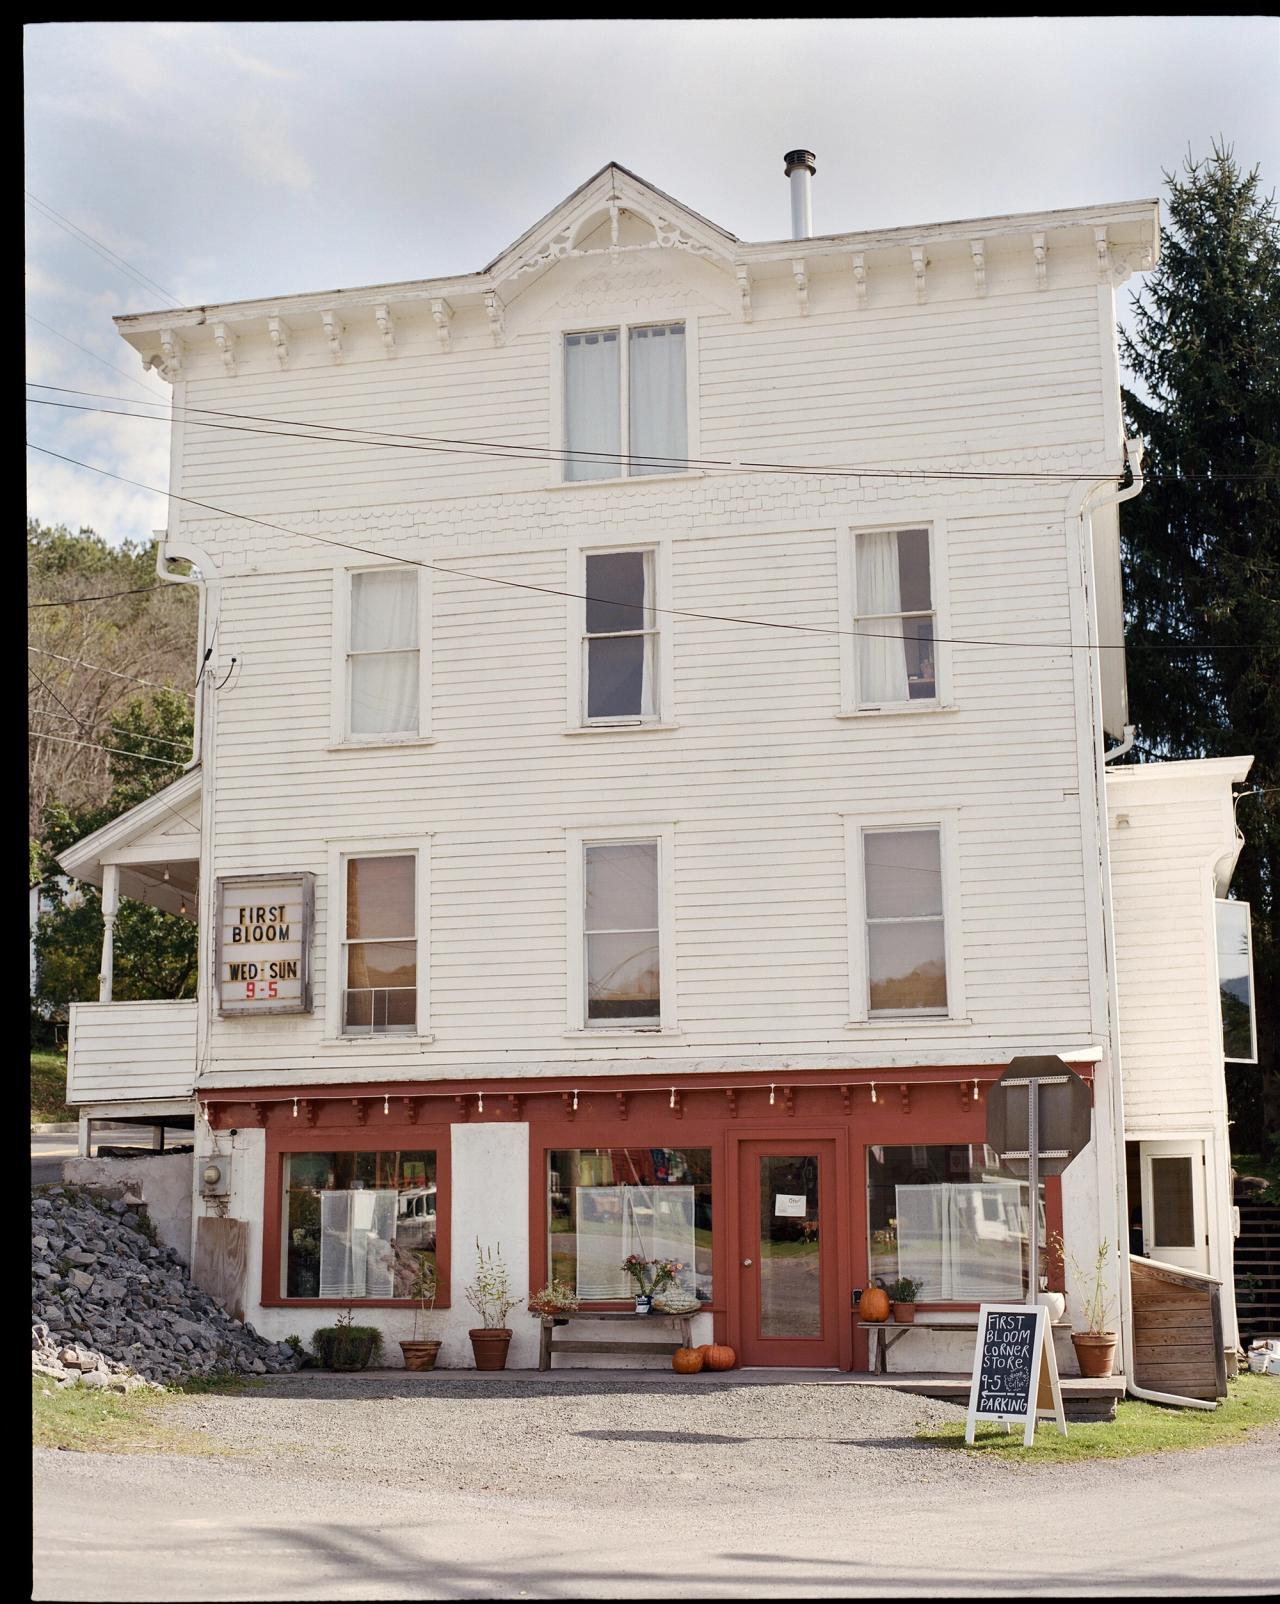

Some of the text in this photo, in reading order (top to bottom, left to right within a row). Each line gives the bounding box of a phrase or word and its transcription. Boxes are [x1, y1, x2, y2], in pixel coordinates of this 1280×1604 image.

[239, 905, 286, 925] FIRST
[232, 925, 290, 943] BLOOM
[987, 1314, 1026, 1330] FIRST
[986, 1330, 1031, 1343] BLOOM
[981, 1374, 1001, 1391] 9-5
[980, 1398, 1028, 1412] PARKING
